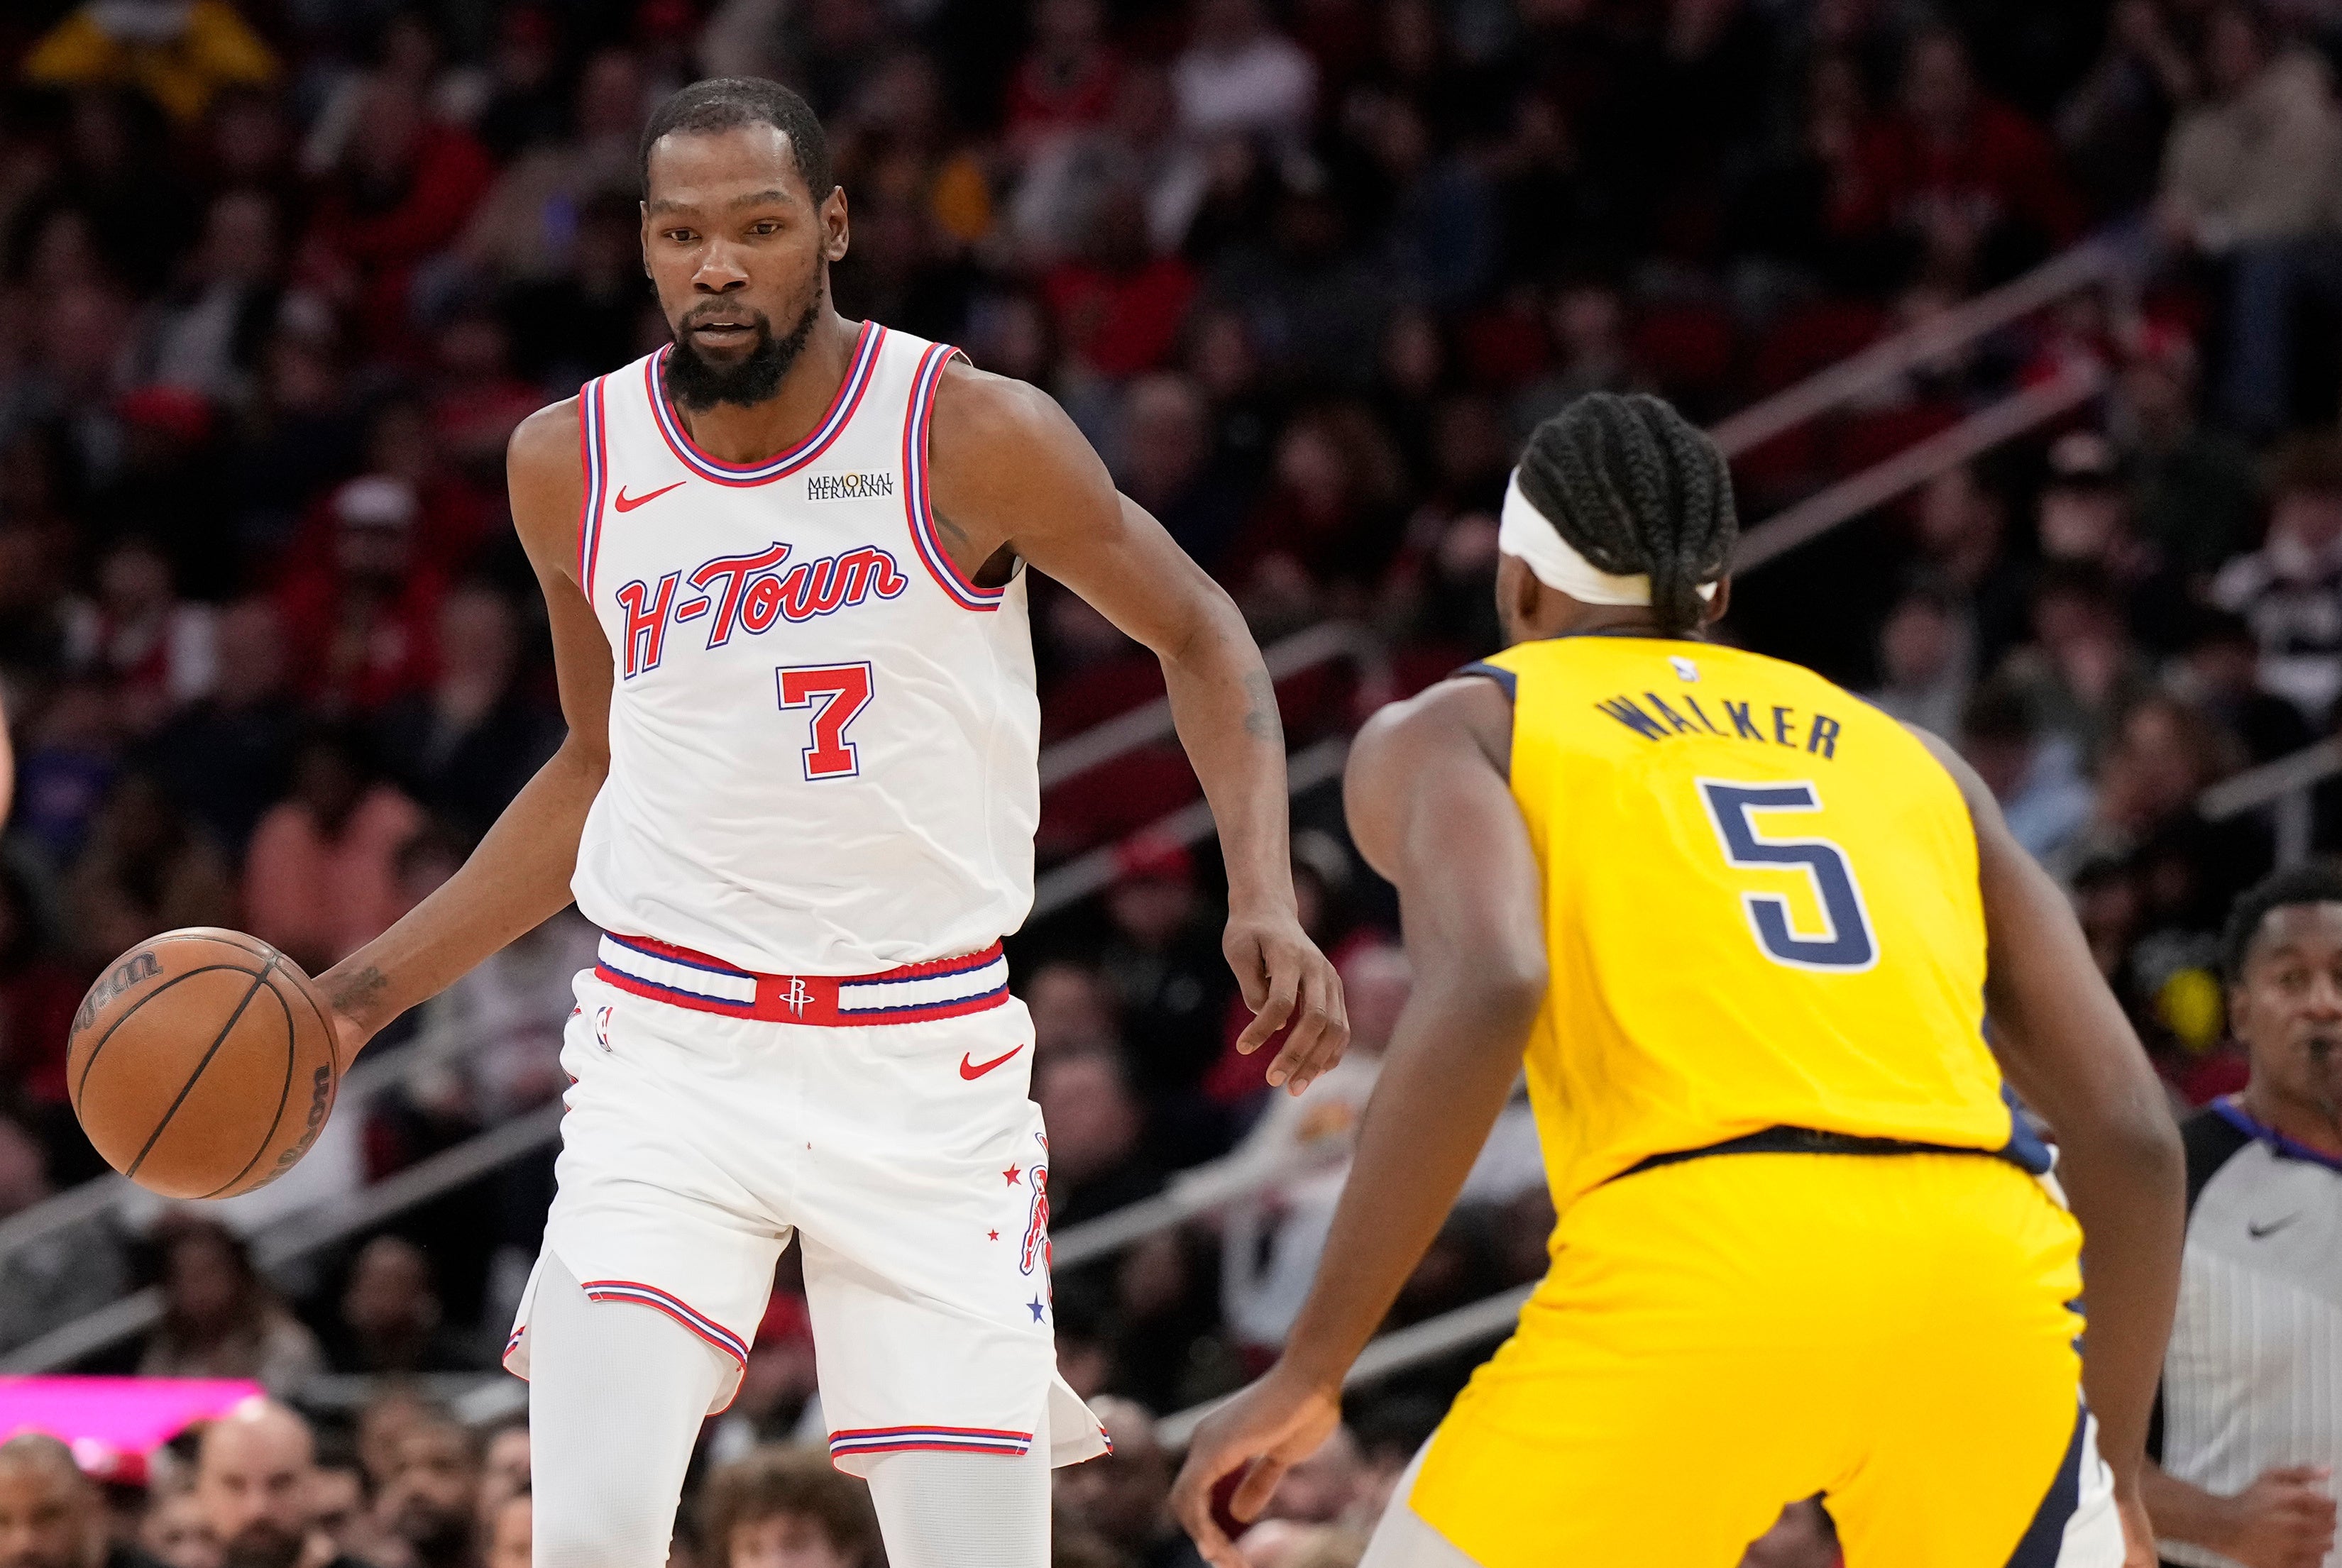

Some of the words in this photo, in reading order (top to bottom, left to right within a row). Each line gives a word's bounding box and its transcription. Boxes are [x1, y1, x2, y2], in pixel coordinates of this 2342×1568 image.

[808, 473, 894, 490] MEMORIAL
[808, 483, 893, 500] HERMANN
[615, 541, 908, 680] H-Town
[776, 661, 874, 781] 7
[1594, 690, 1840, 761] WALKER
[1695, 777, 1880, 973] 5
